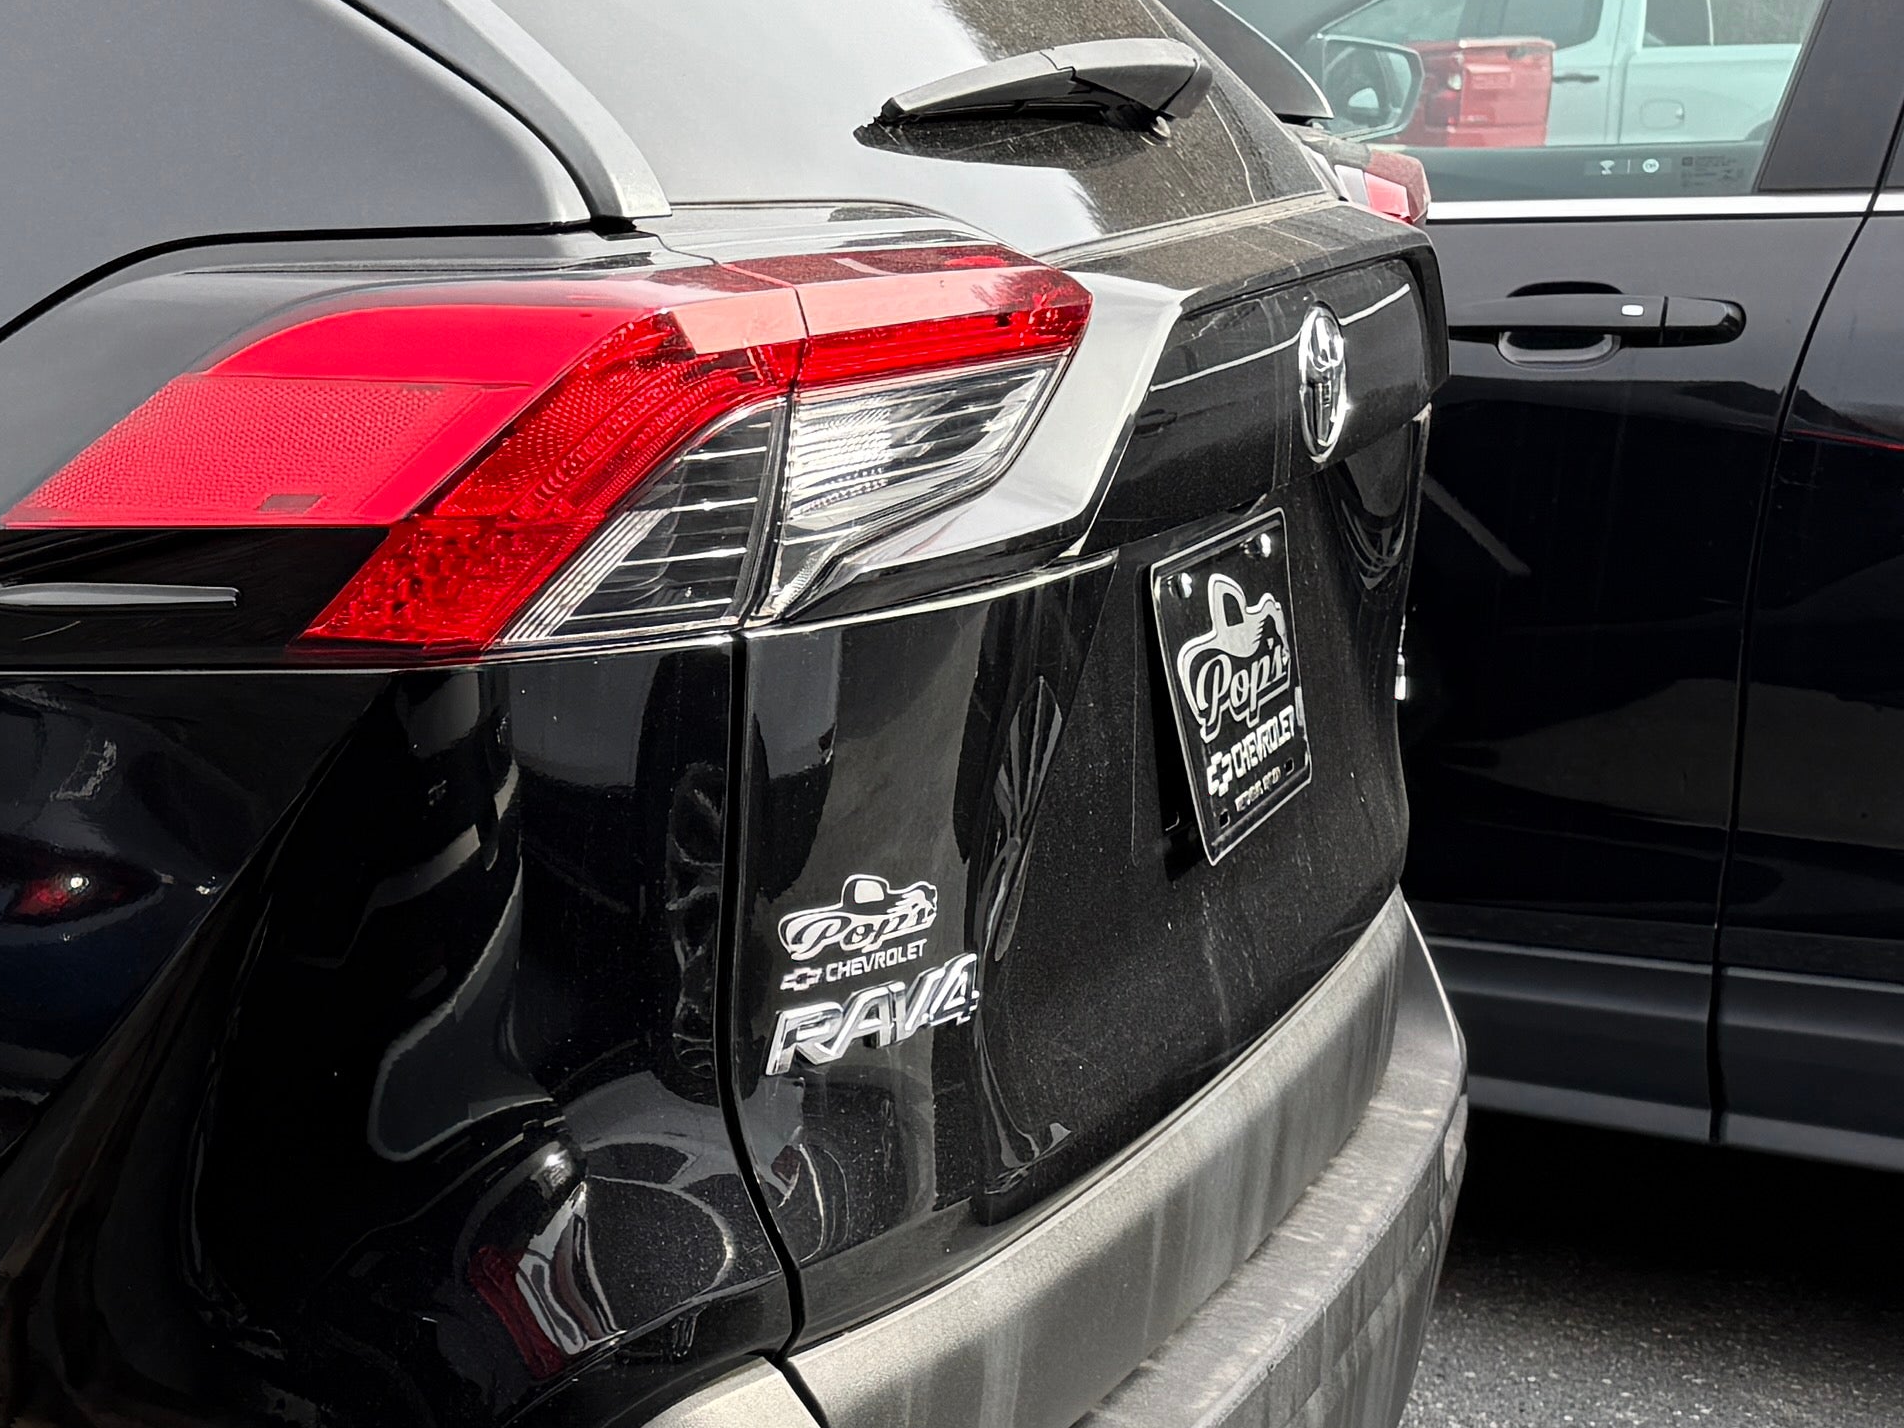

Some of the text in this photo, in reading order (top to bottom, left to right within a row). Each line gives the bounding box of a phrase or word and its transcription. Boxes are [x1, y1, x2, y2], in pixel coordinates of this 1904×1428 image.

[1230, 705, 1294, 778] CHEVROLET
[826, 939, 927, 982] CHEVROLET
[765, 953, 980, 1075] RAV4
